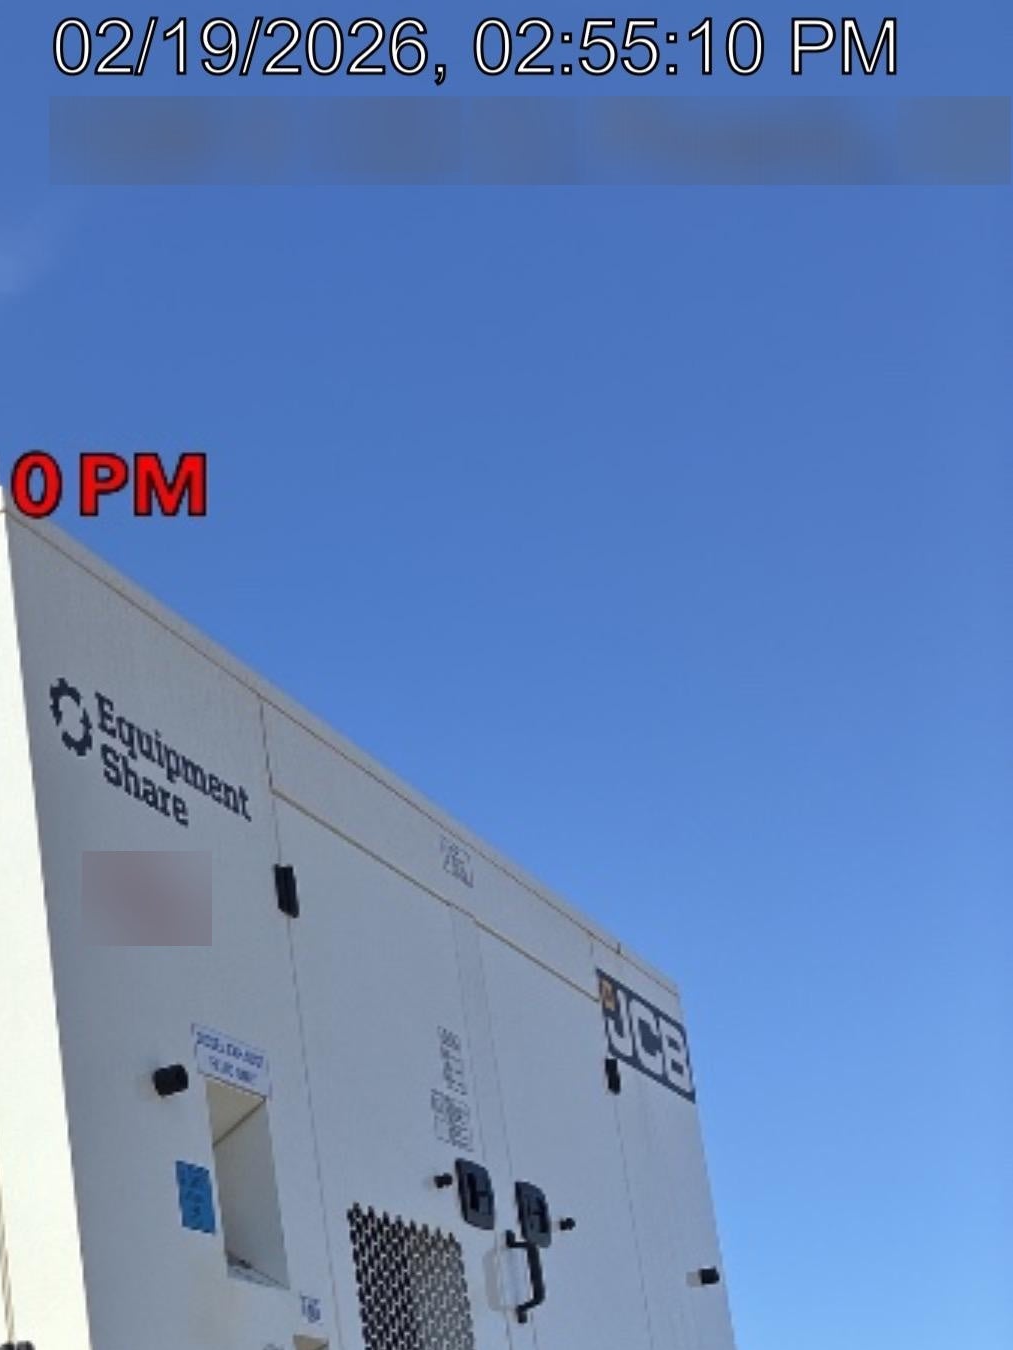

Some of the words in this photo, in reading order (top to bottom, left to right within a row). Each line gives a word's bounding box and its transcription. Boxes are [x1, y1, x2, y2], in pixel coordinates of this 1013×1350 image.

[95, 691, 252, 823] Equipment
[101, 743, 189, 827] Share
[606, 988, 693, 1094] JCB
